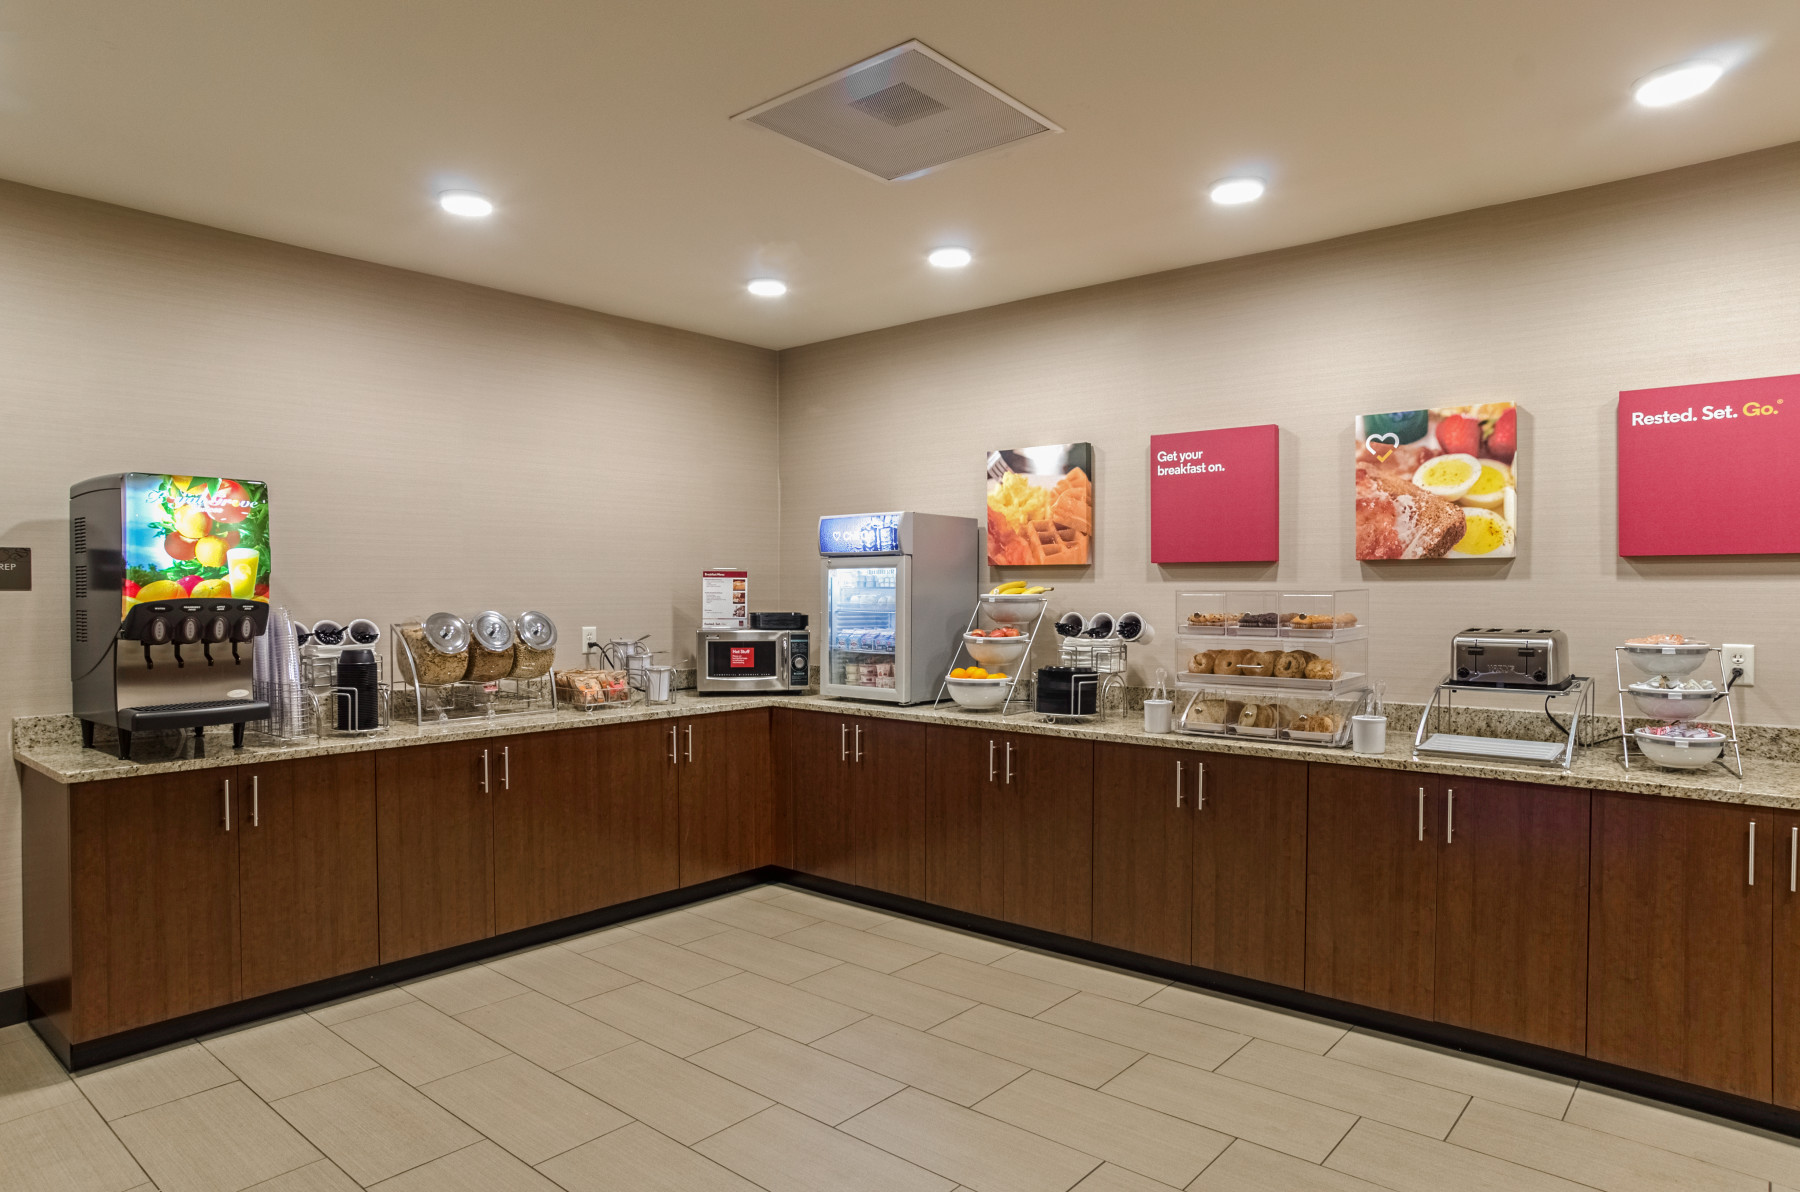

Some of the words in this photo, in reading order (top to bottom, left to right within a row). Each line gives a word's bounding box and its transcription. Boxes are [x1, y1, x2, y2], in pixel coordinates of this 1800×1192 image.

[1631, 407, 1698, 426] Rested.
[1701, 405, 1738, 420] Set.
[1157, 451, 1178, 462] Get
[1179, 451, 1204, 463] your
[1157, 462, 1206, 476] breakfast
[1207, 463, 1226, 472] on.
